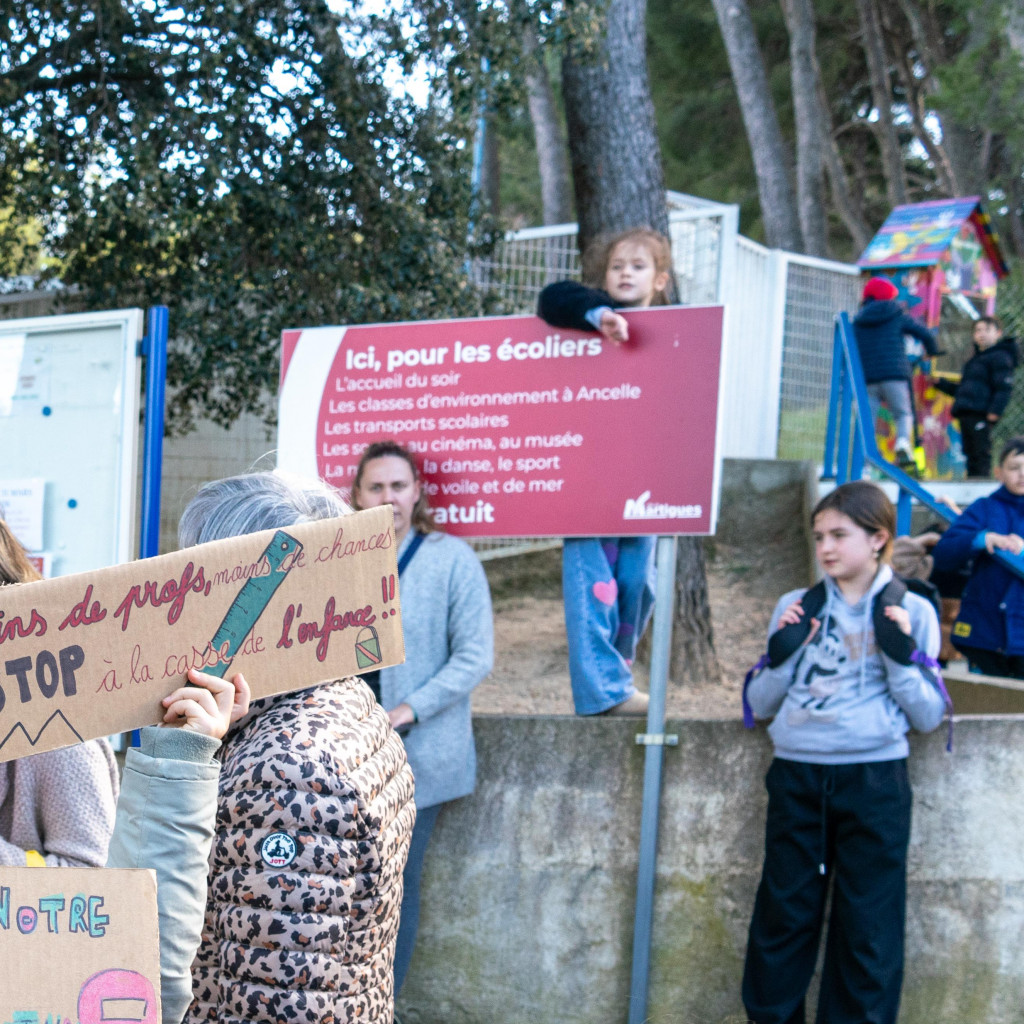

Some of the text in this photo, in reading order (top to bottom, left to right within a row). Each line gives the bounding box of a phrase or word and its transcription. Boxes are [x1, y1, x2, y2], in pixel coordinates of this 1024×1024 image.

[345, 334, 603, 372] Ici, pour les écoliers
[335, 370, 461, 392] L'accueil du soir
[328, 383, 641, 414] Les classes d'environnement à Ancelle
[324, 414, 510, 435] Les transports scolaires
[322, 442, 350, 456] Les
[431, 436, 496, 452] cinéma,
[499, 435, 521, 450] au
[525, 430, 584, 449] musée
[325, 463, 344, 478] La
[423, 458, 438, 474] la
[440, 457, 495, 474] danse,
[497, 455, 513, 471] le
[515, 455, 561, 473] sport
[441, 479, 480, 495] voile
[482, 478, 499, 494] et
[502, 477, 526, 493] de
[528, 478, 565, 492] mer
[58, 584, 108, 632] de
[113, 561, 212, 632] profs,
[213, 554, 272, 586] moins
[277, 544, 306, 572] de
[315, 526, 394, 563] chances
[96, 659, 123, 693] à
[129, 644, 154, 684] la
[161, 639, 234, 680] casse
[241, 626, 265, 656] de
[276, 596, 377, 662] l'enfance
